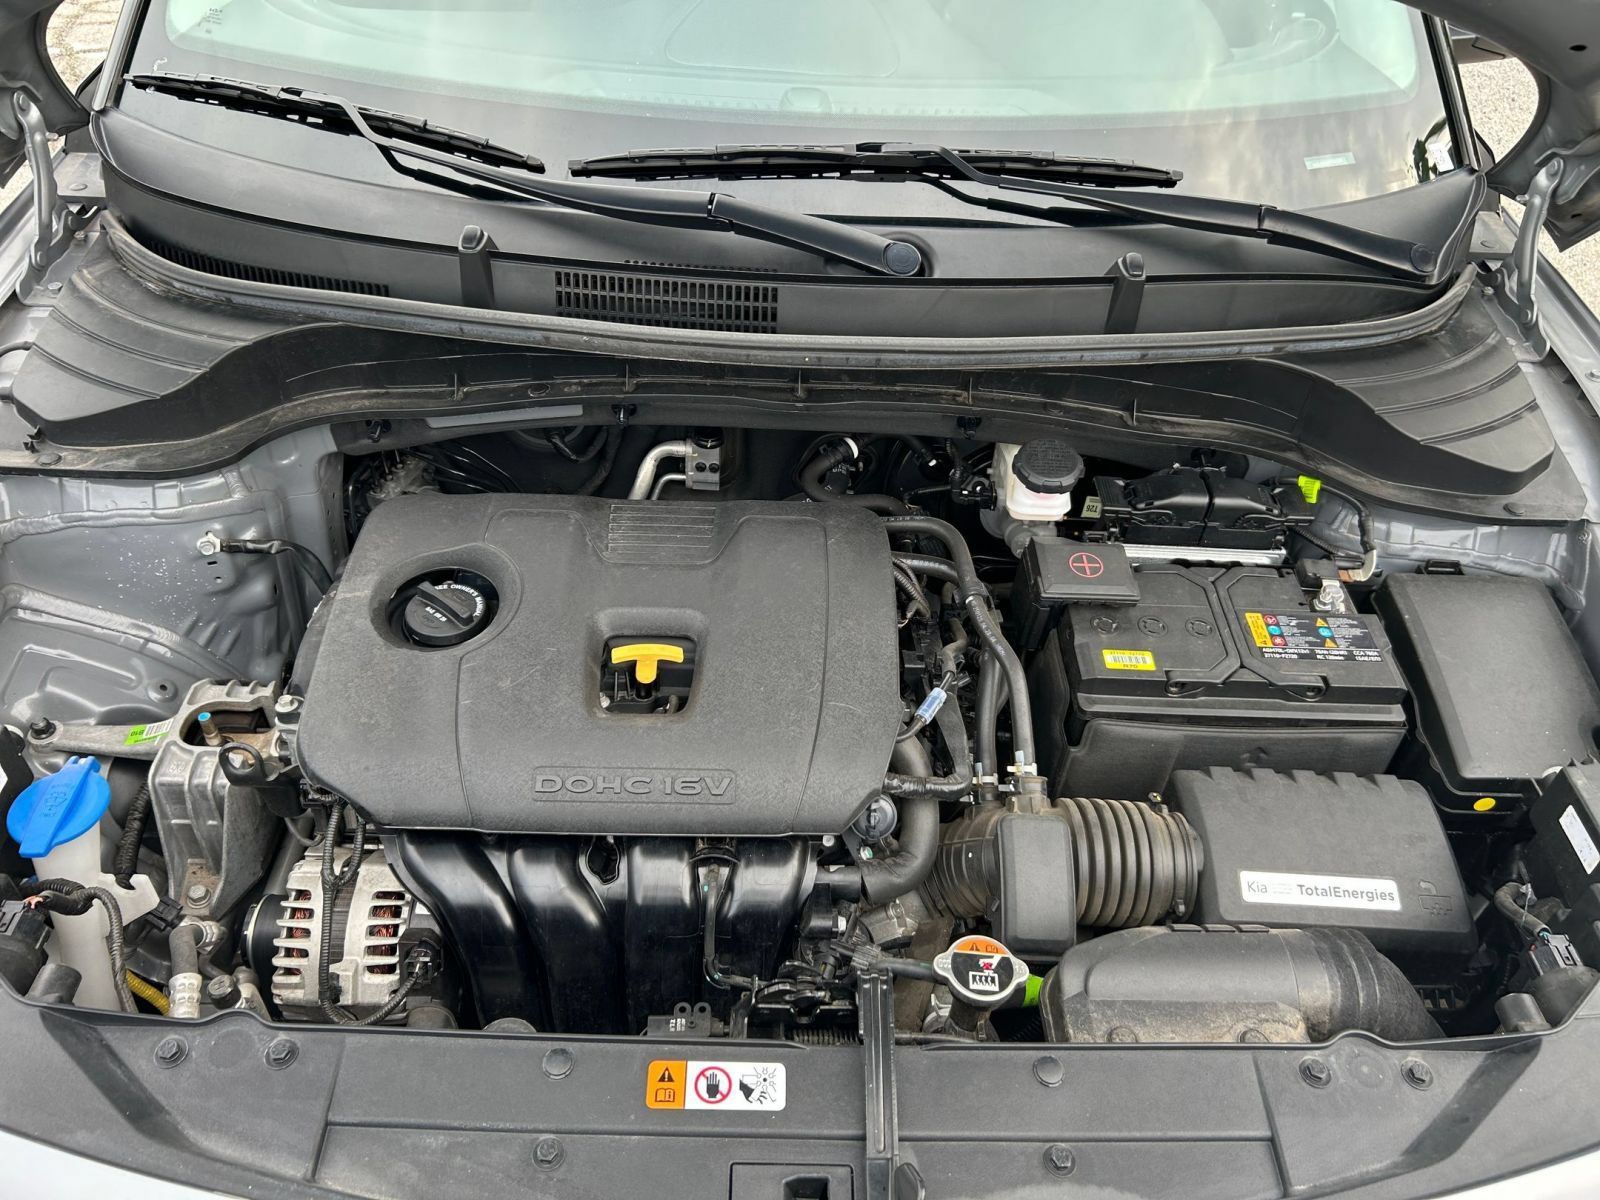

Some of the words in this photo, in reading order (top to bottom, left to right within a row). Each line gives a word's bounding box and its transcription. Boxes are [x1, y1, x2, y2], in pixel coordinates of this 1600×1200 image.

[1086, 504, 1098, 513] T26
[450, 584, 479, 597] OWNER'S
[473, 596, 484, 617] MANUAL
[535, 775, 653, 795] DOHC
[663, 776, 733, 797] 16V
[1247, 881, 1268, 894] Kia
[1297, 884, 1396, 902] TotalEnergies
